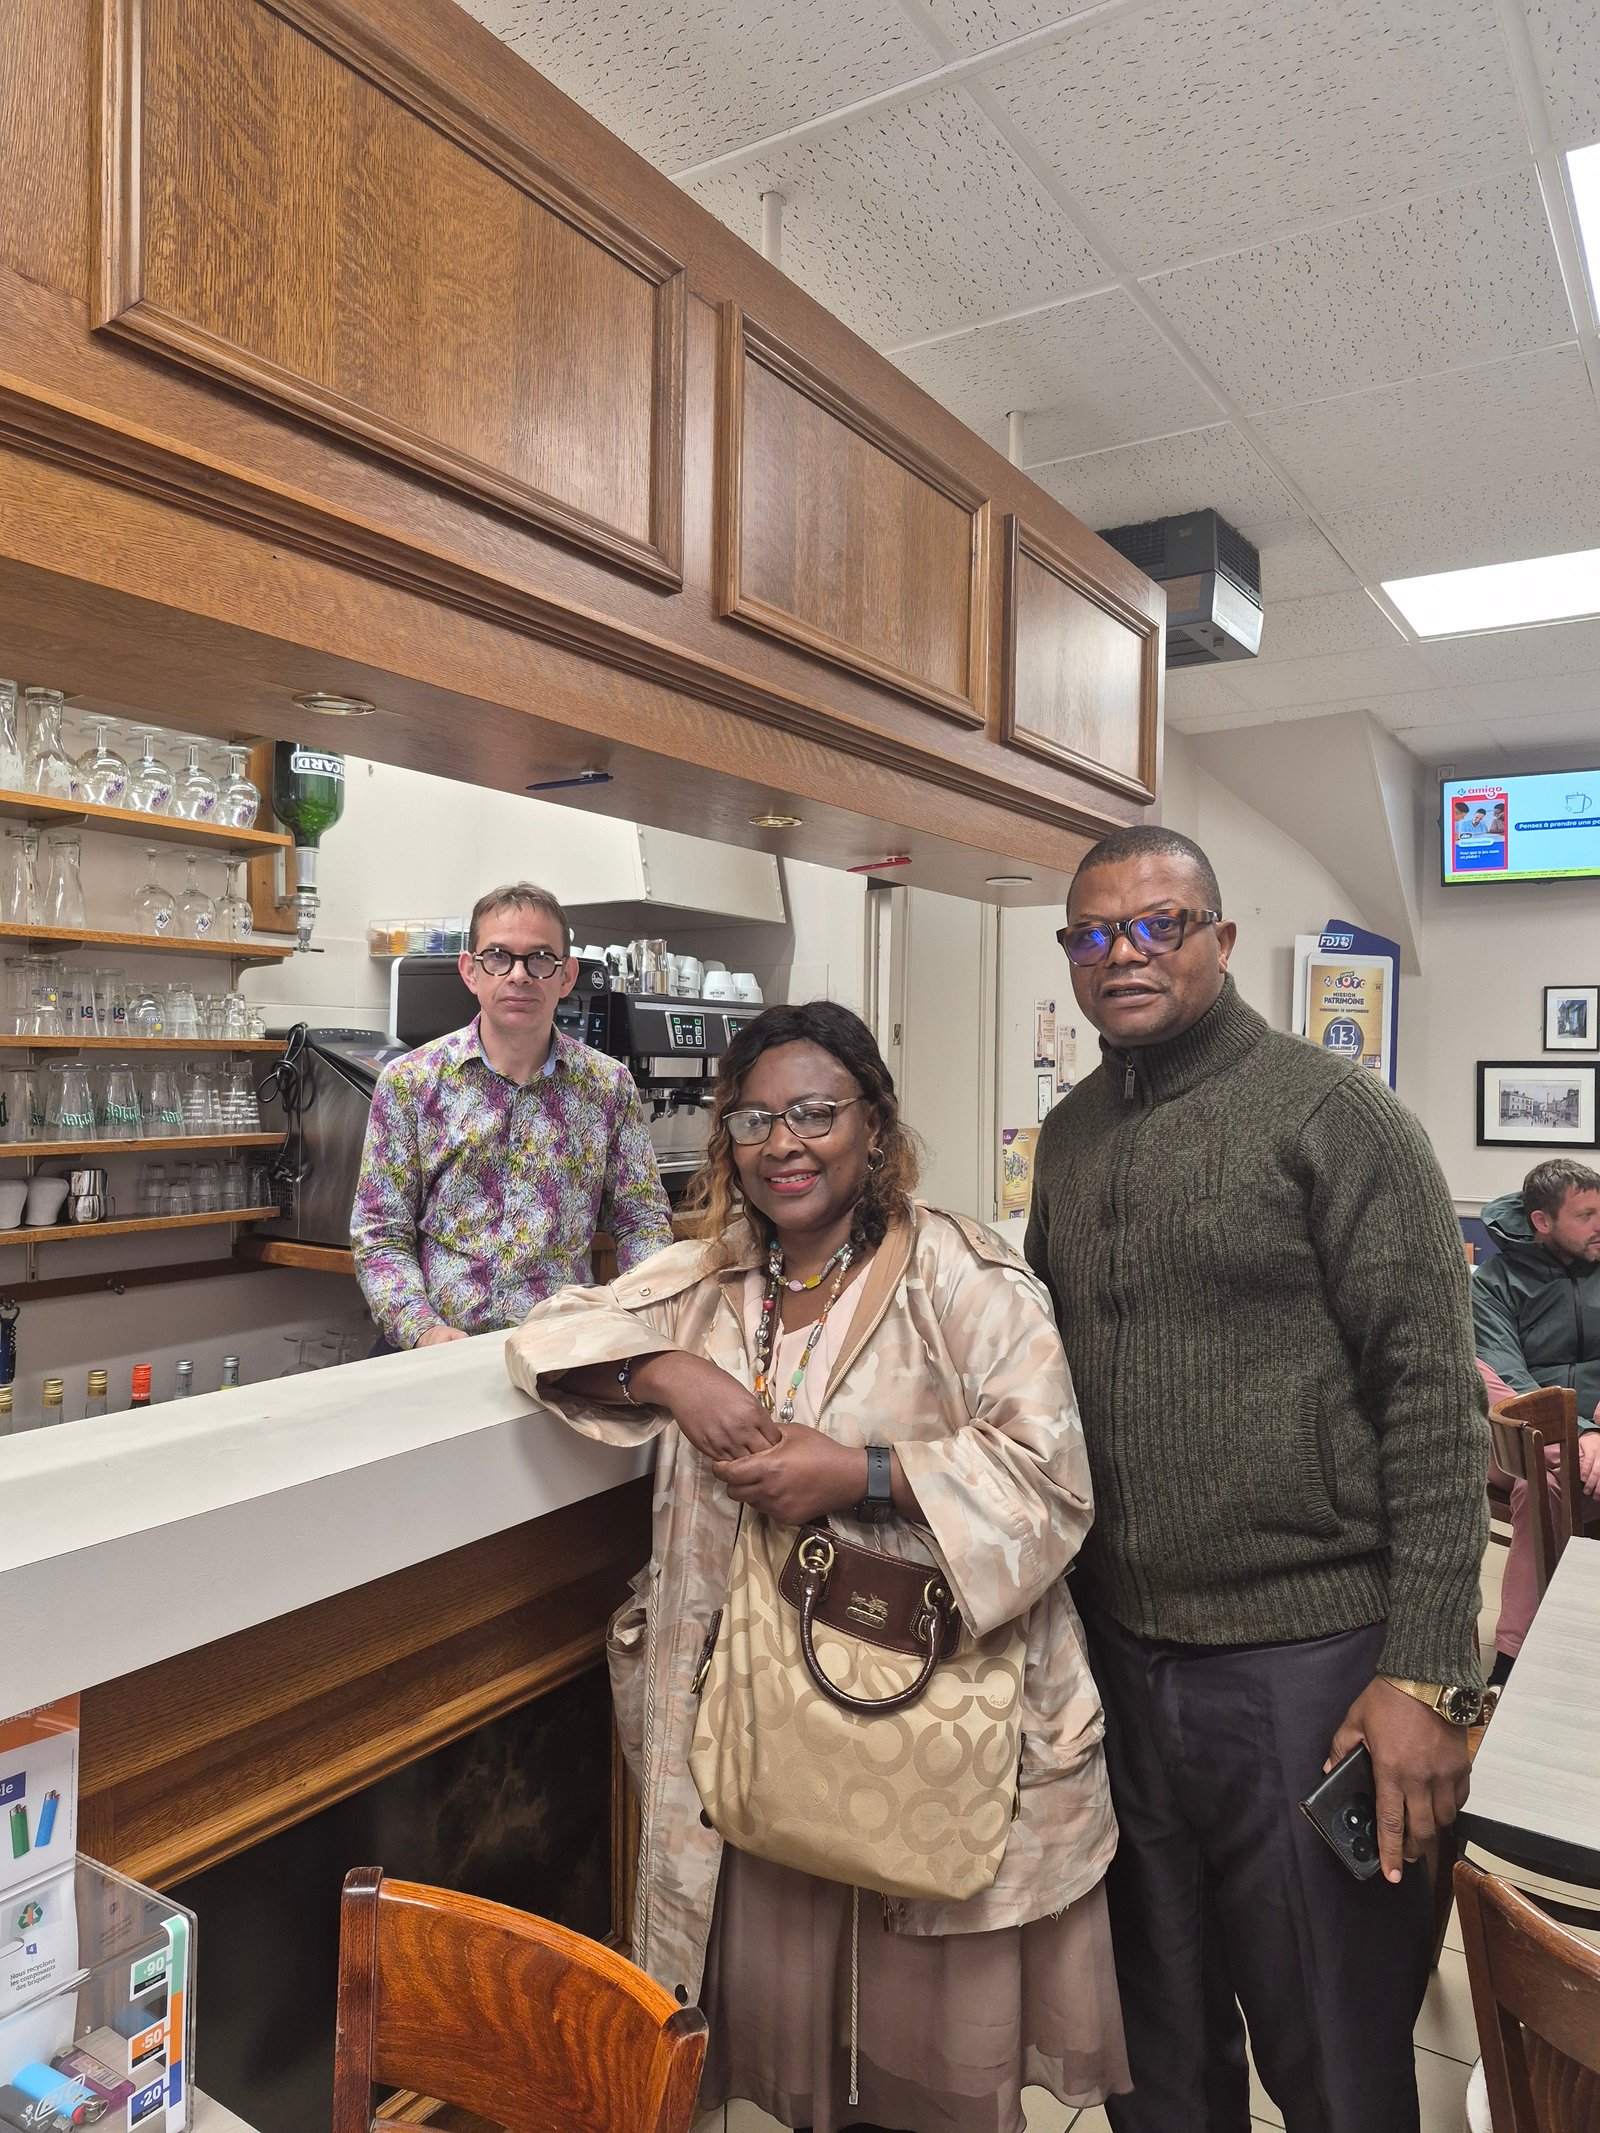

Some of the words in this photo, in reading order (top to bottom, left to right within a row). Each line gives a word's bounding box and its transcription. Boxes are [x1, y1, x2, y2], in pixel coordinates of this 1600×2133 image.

[299, 757, 344, 776] ICARD
[1468, 785, 1502, 797] amigo
[1550, 820, 1577, 829] prendre
[1320, 935, 1340, 946] FDJ
[1335, 976, 1367, 989] LOTO
[1323, 996, 1365, 1005] PATRIMOINE
[79, 1006, 94, 1019] 51
[111, 1007, 126, 1020] 51
[1331, 1025, 1356, 1046] 13
[0, 1783, 14, 1797] le
[10, 1970, 26, 1981] Nous
[26, 1958, 56, 1974] recyclons
[10, 1979, 20, 1987] les
[20, 1964, 57, 1982] composants
[15, 1983, 27, 1991] des
[27, 1972, 52, 1987] briquets
